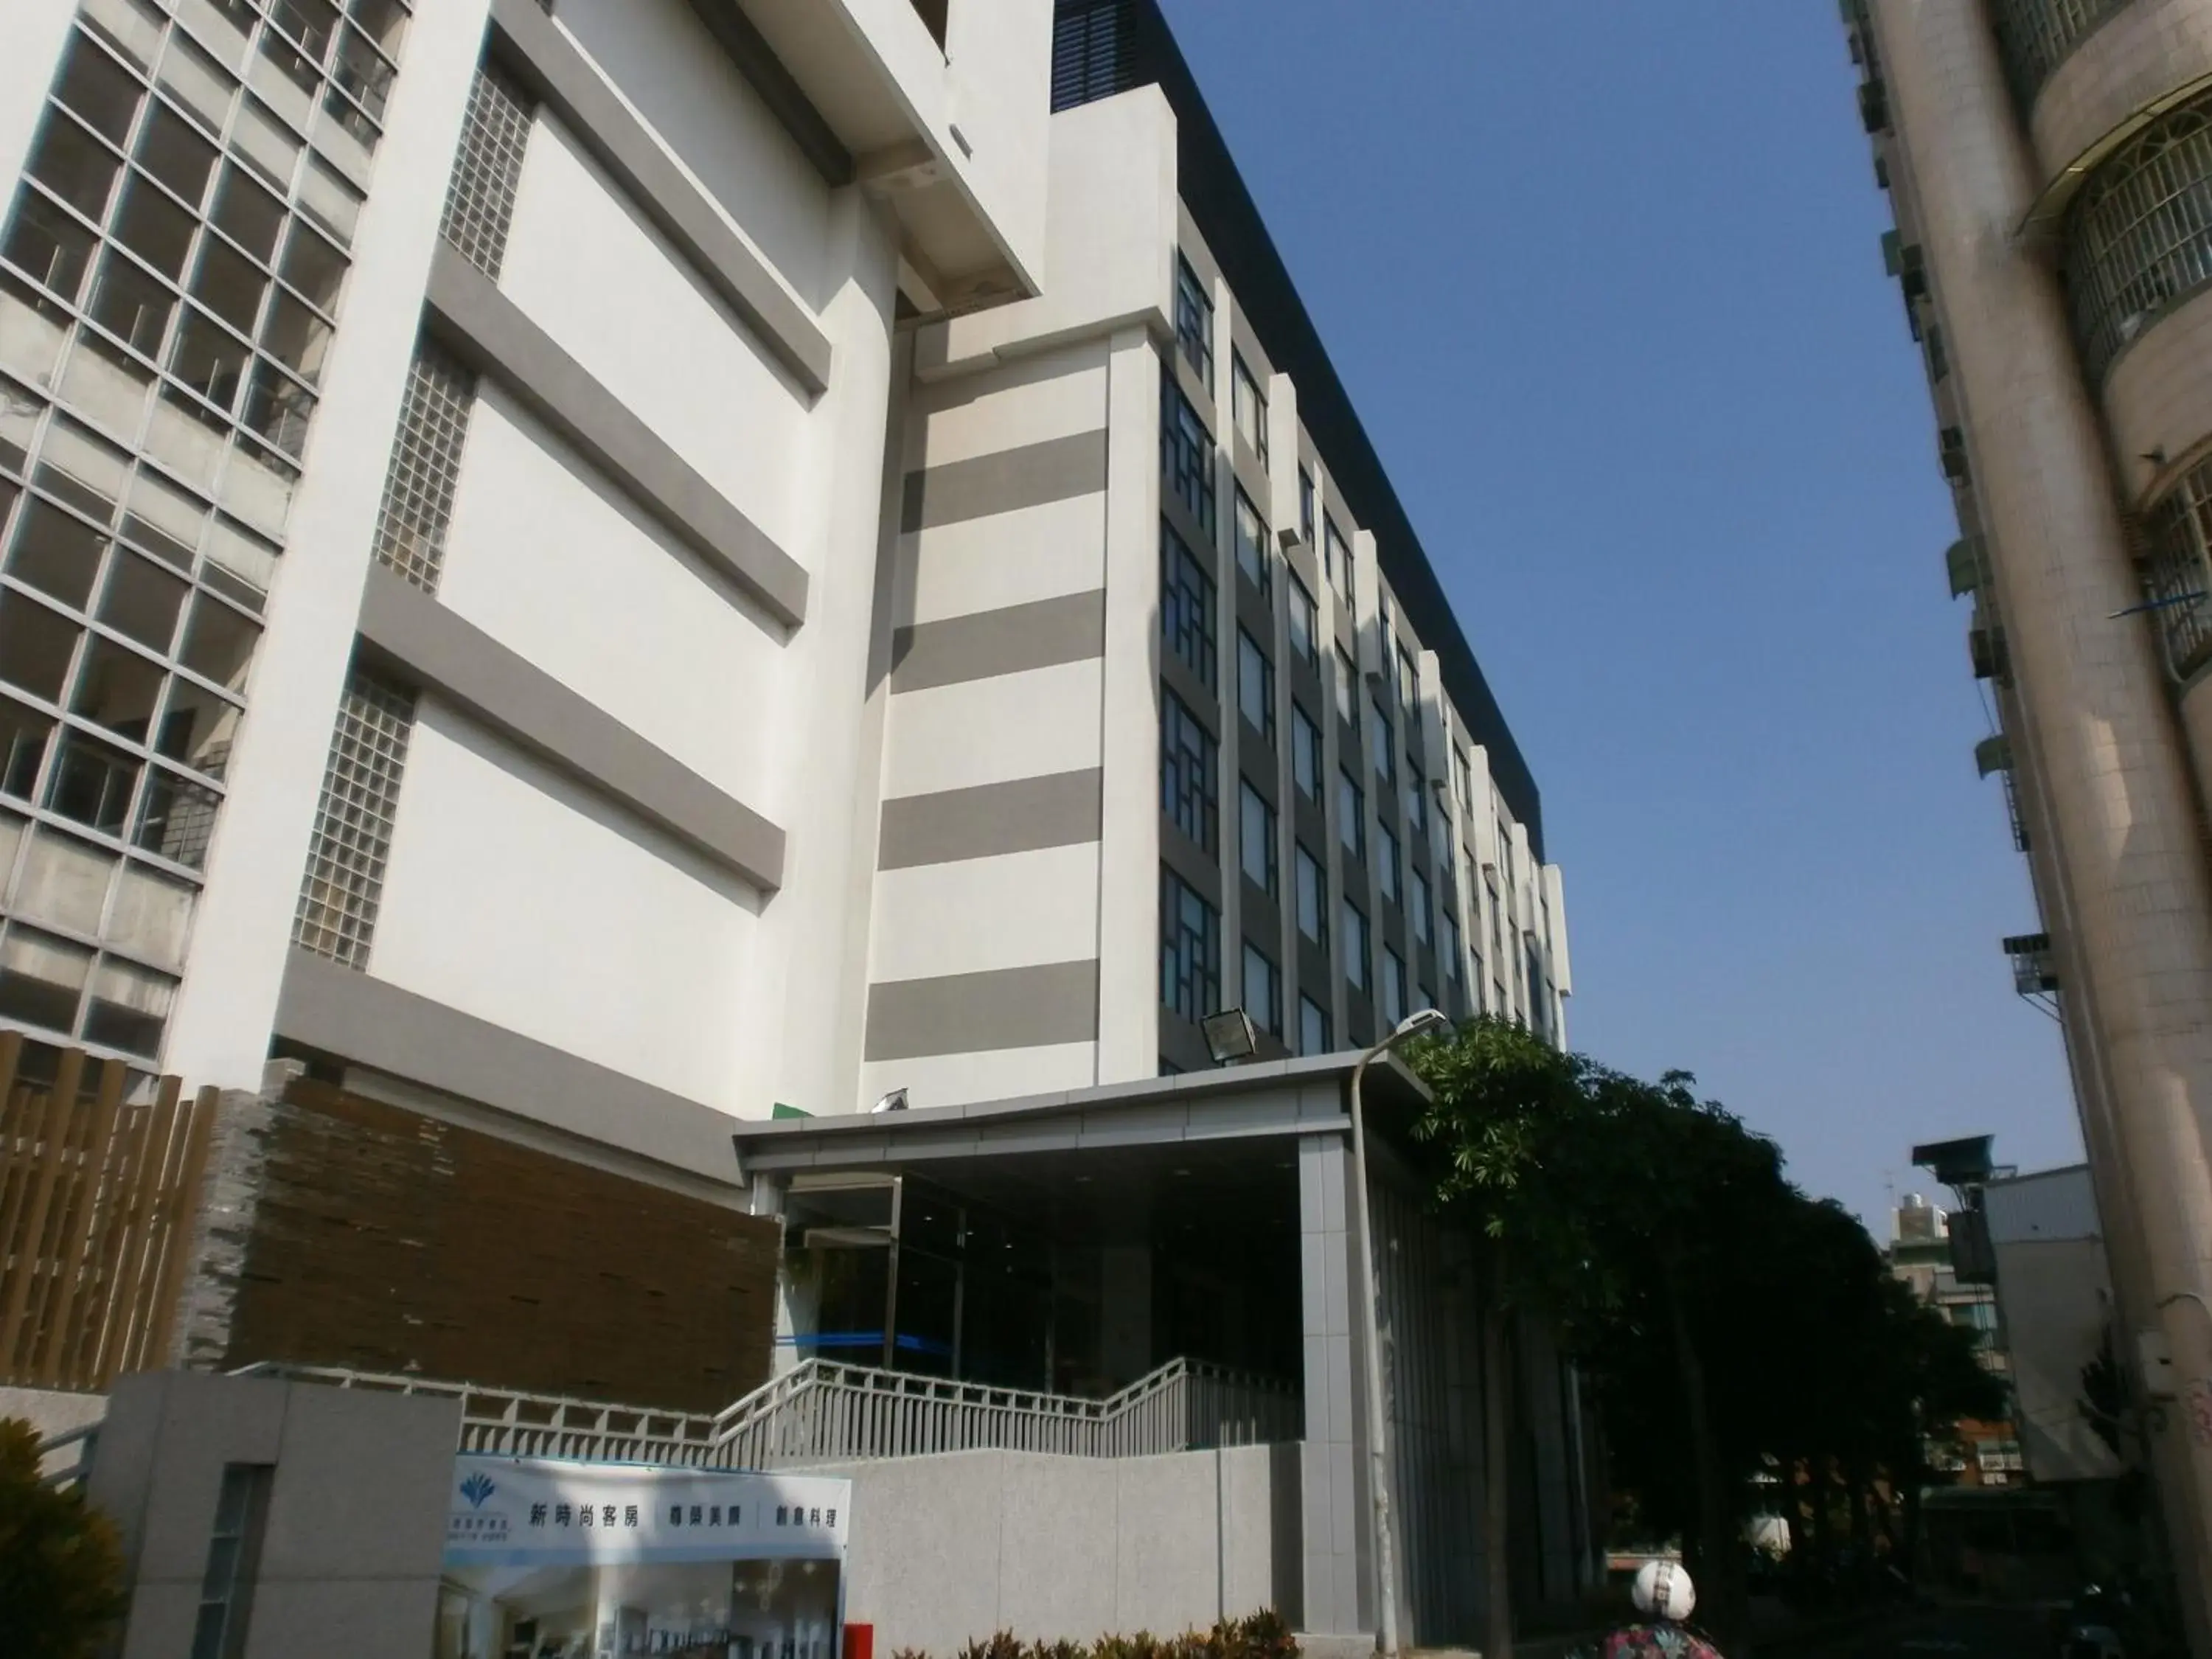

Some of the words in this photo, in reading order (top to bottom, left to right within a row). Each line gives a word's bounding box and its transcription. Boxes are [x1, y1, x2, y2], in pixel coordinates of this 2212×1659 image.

[529, 1501, 639, 1527] 新時尚客房
